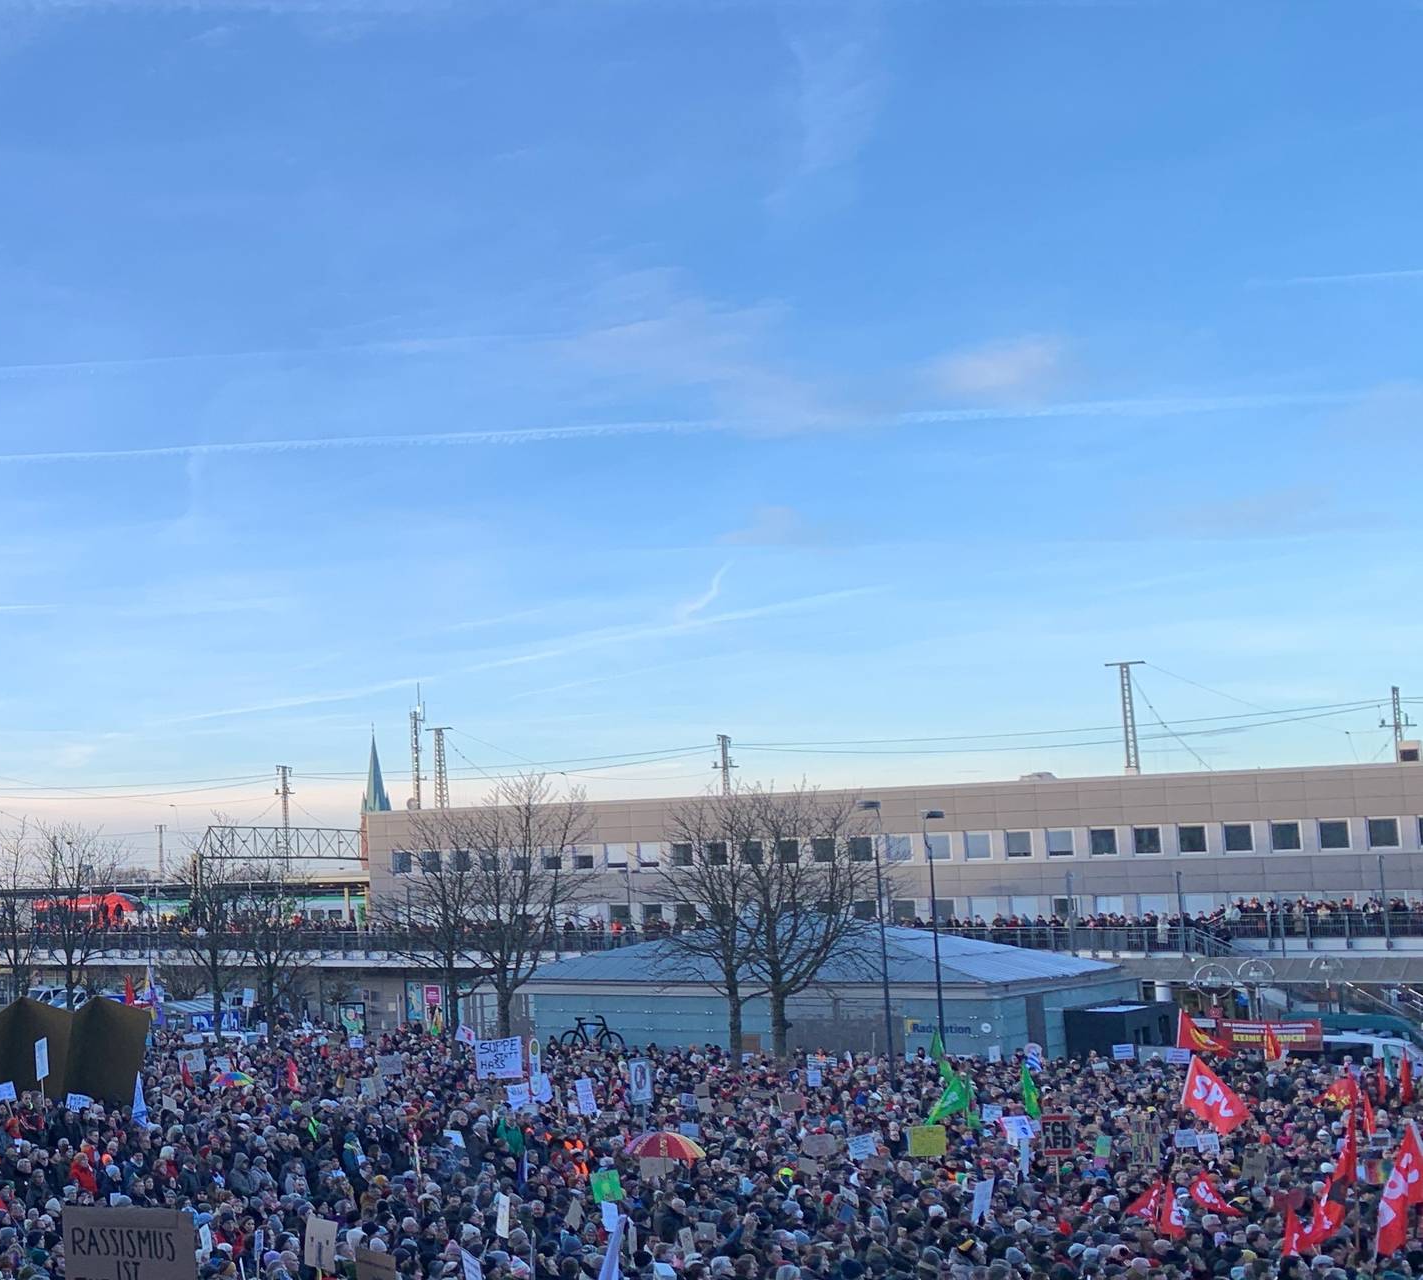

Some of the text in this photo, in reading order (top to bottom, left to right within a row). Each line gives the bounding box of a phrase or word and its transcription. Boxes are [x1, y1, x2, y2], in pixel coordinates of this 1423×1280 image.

[913, 1023, 971, 1034] Radation
[478, 1038, 518, 1055] SUPPE
[494, 1051, 519, 1063] STATT
[480, 1059, 506, 1070] HASS
[1041, 1121, 1071, 1136] FCK
[1044, 1136, 1072, 1149] AFD
[71, 1227, 175, 1262] RASSISMUS
[117, 1260, 140, 1280] IST
